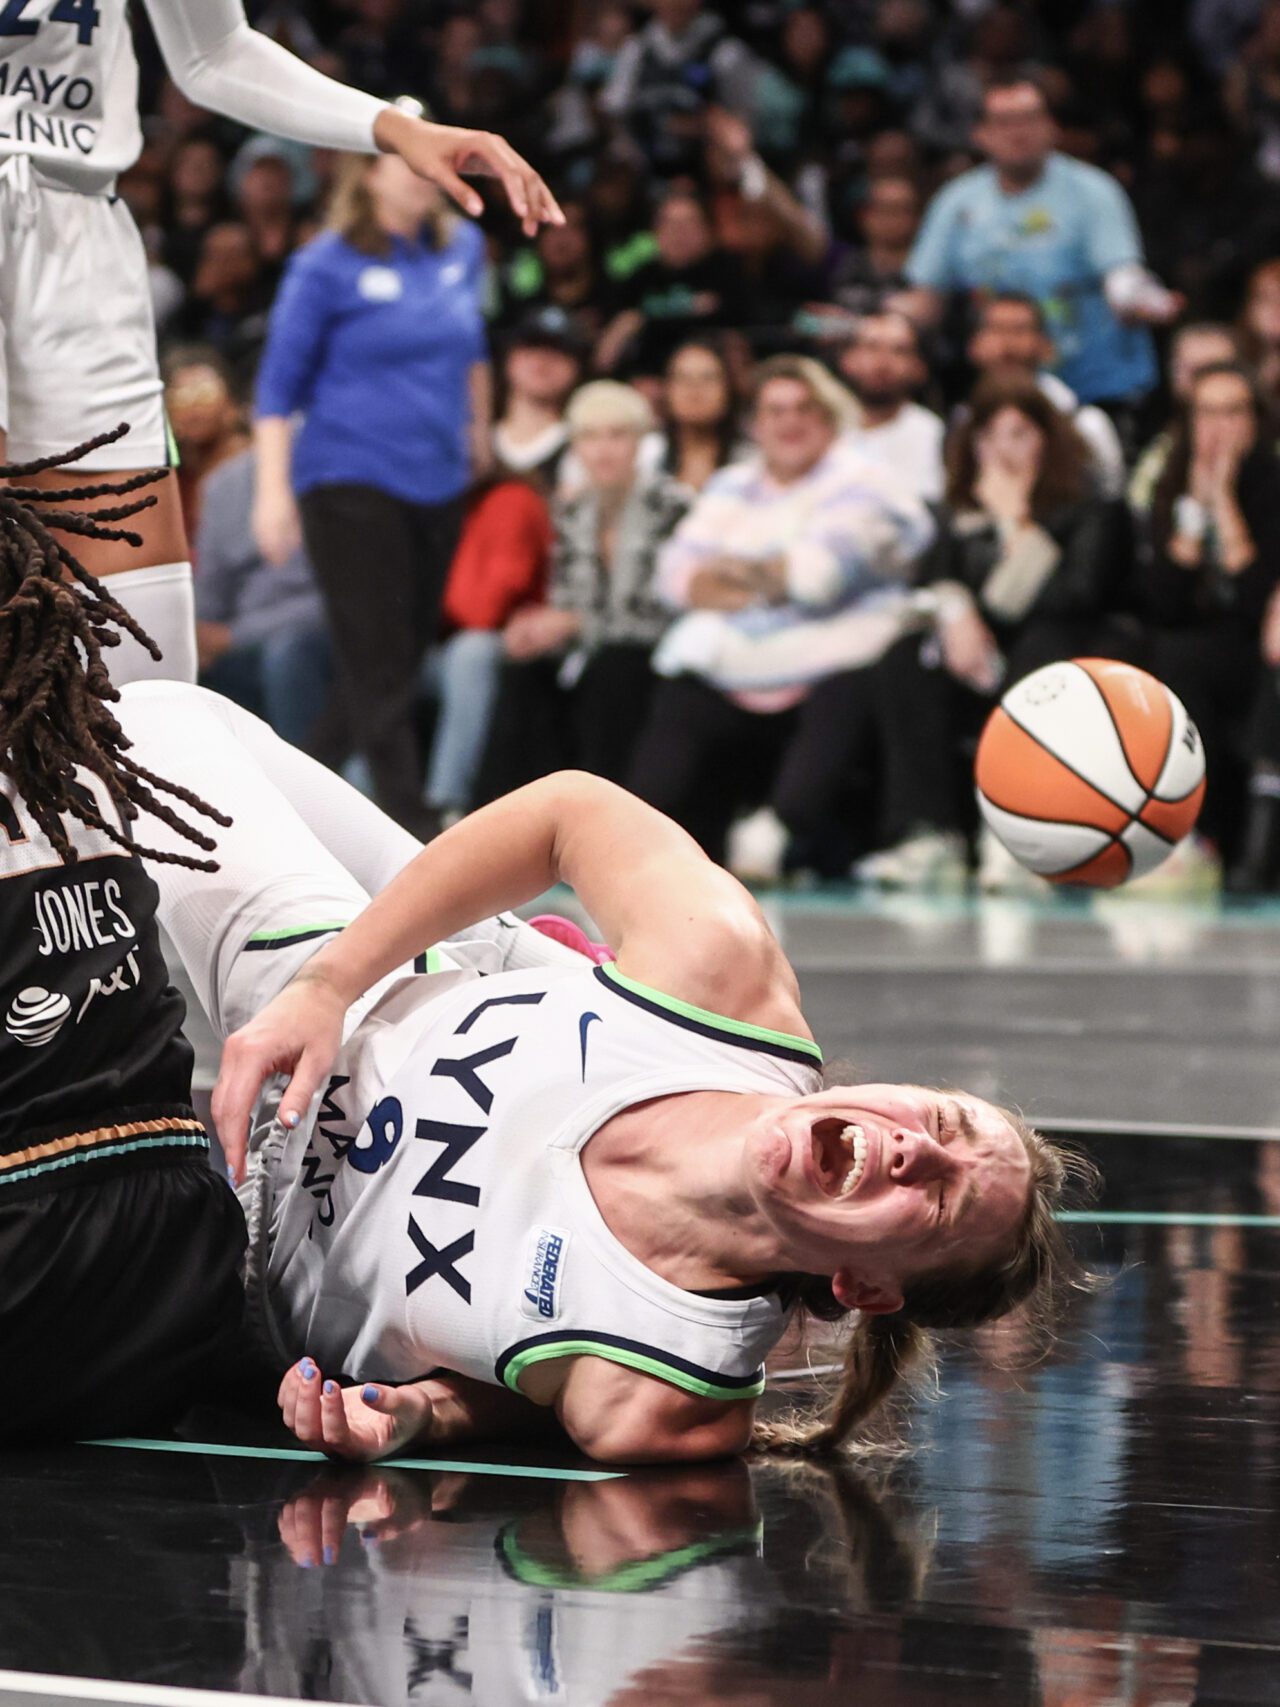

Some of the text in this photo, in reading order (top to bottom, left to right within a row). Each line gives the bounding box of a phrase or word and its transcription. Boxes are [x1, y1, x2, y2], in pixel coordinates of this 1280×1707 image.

[33, 878, 136, 956] JONES
[405, 991, 548, 1306] LYNX
[538, 1234, 563, 1318] FEDERATED
